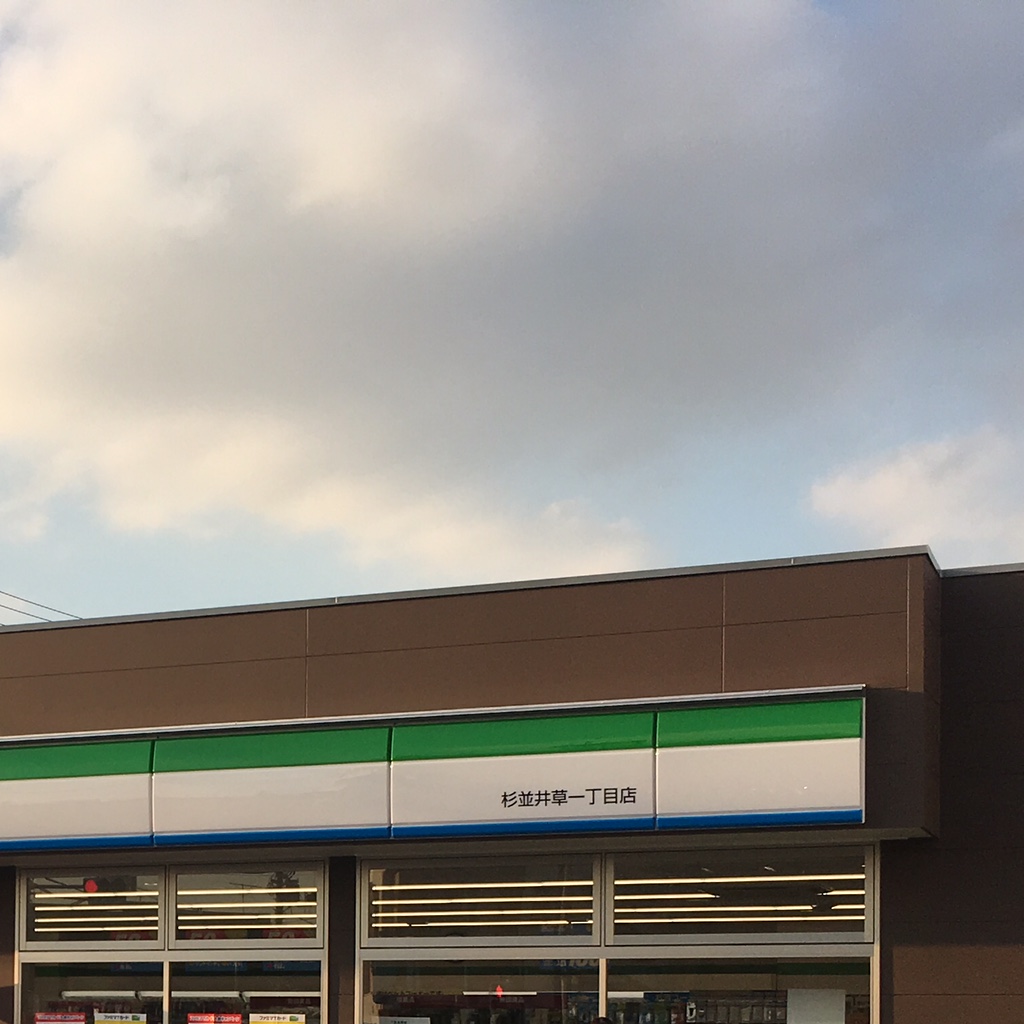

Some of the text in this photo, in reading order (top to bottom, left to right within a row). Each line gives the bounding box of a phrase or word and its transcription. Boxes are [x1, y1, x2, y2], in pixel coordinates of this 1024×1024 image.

[501, 787, 637, 808] 杉並井草一丁目店
